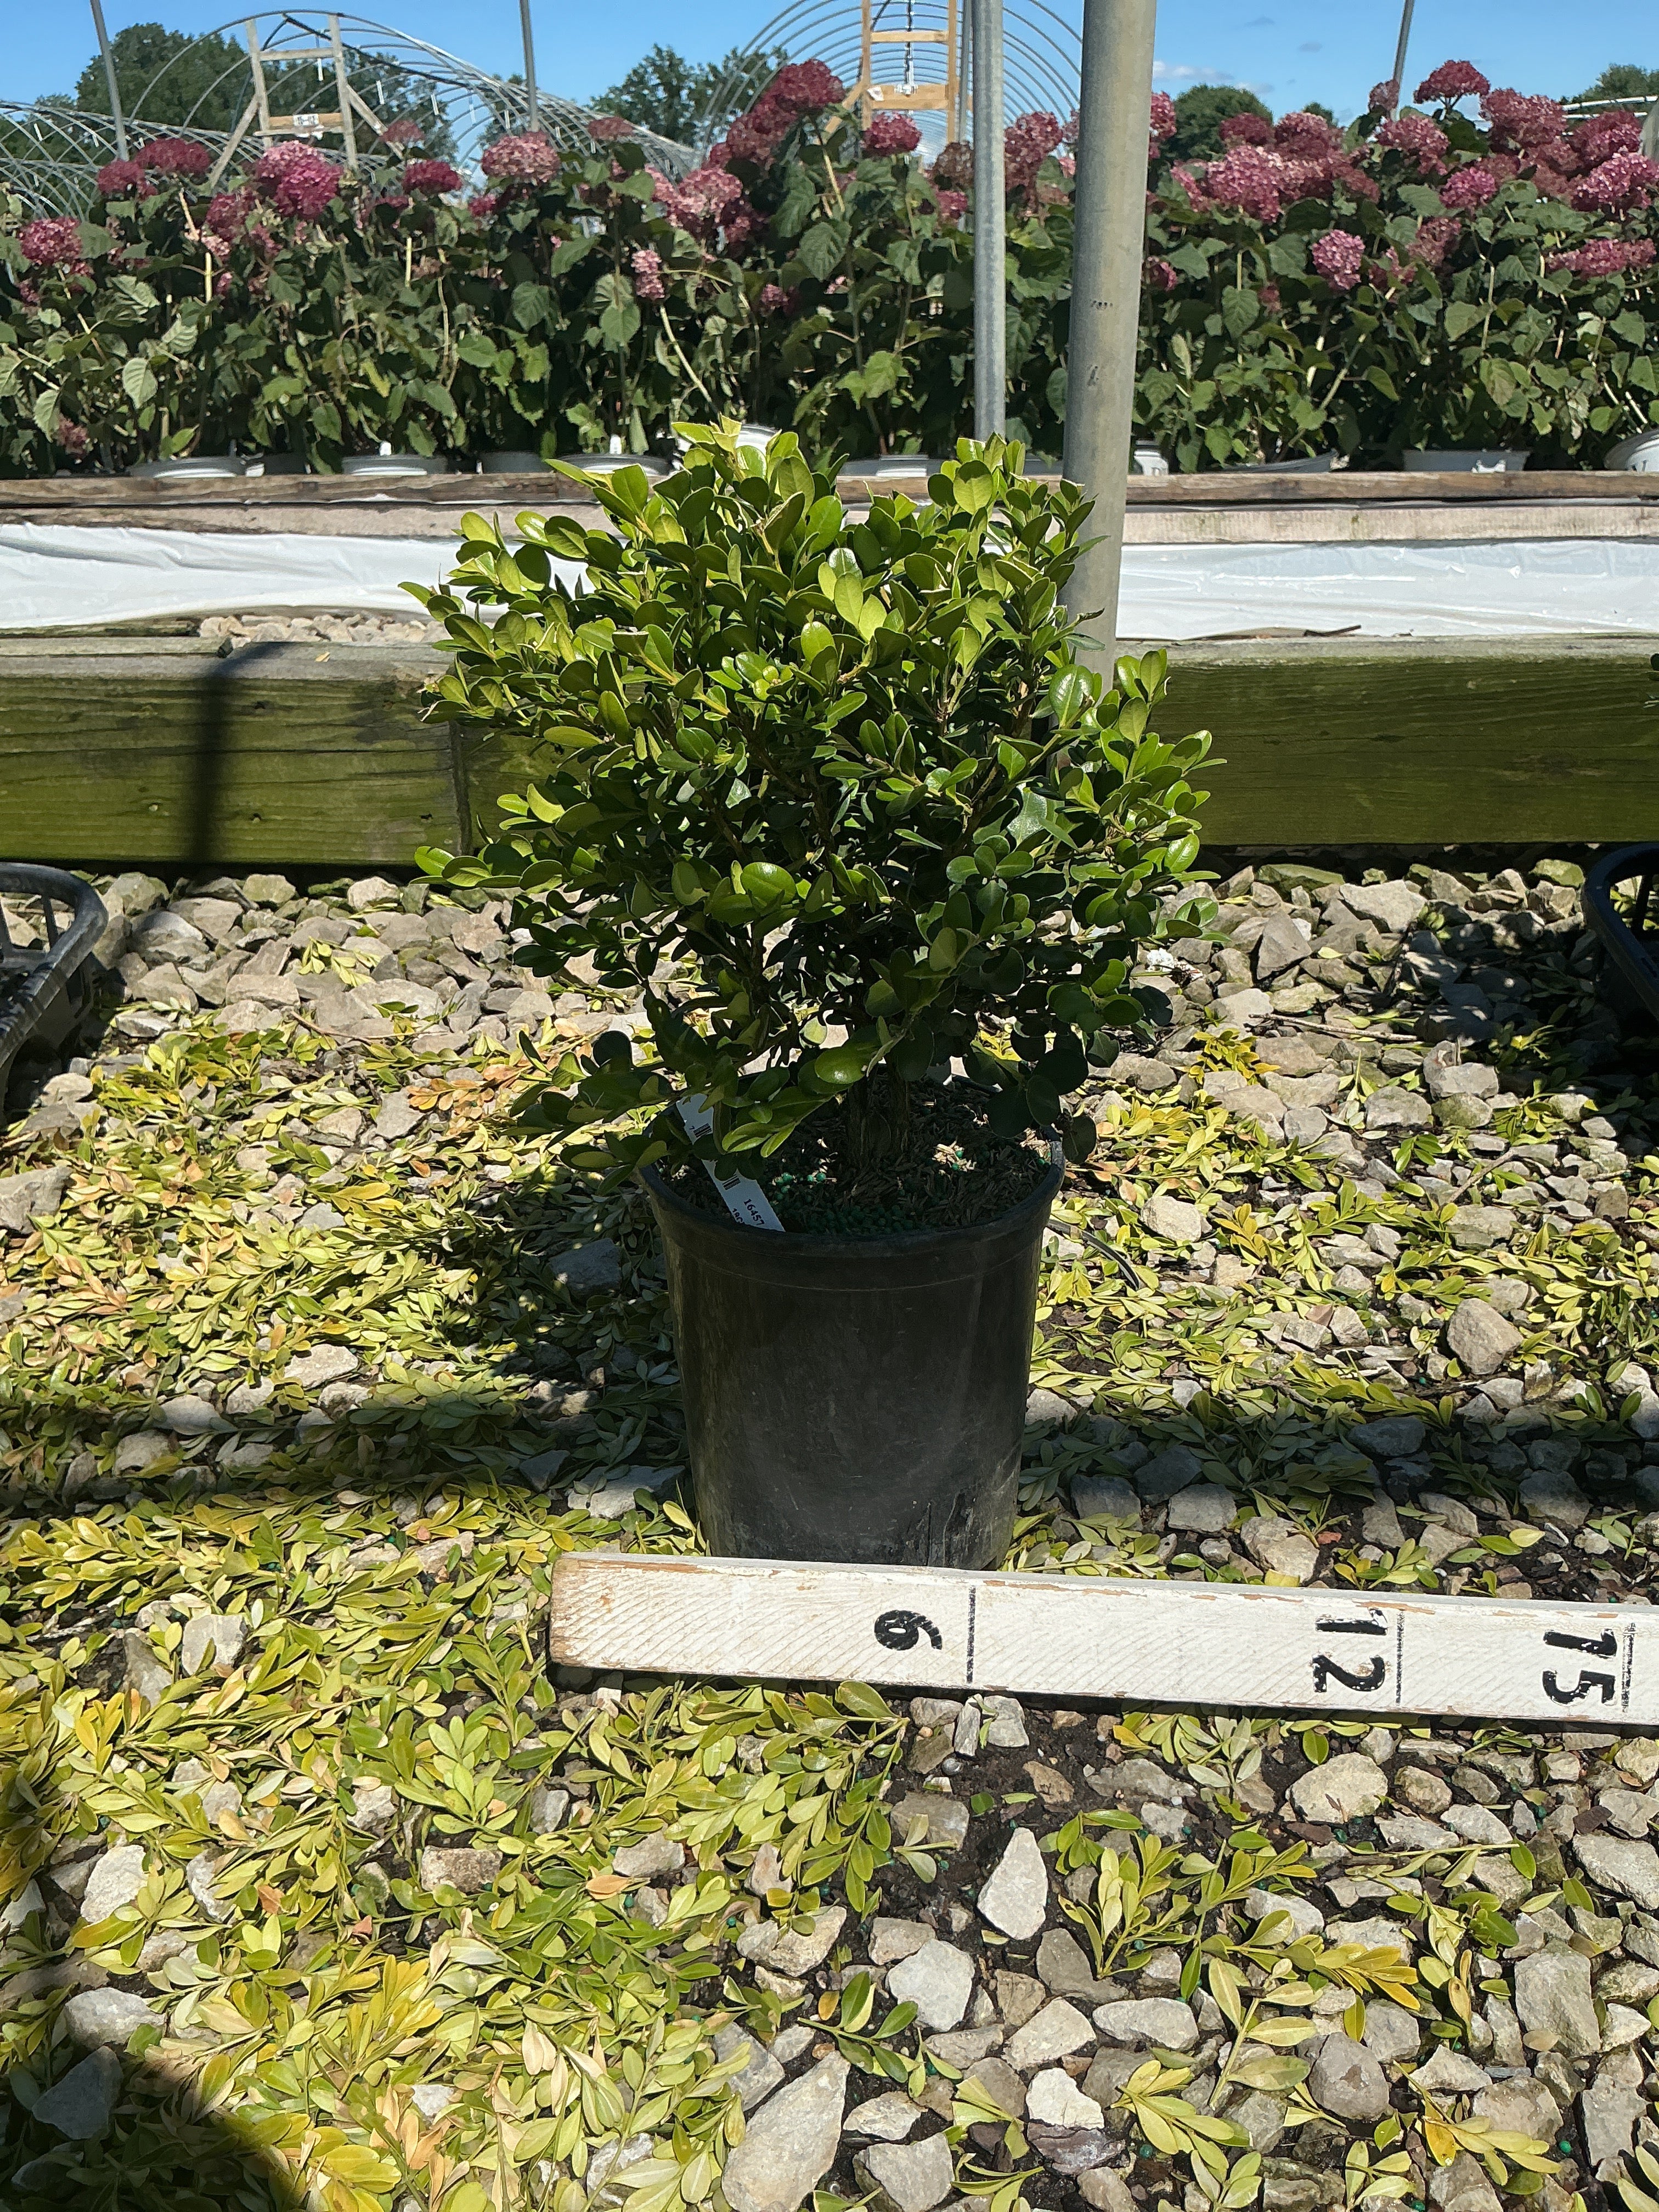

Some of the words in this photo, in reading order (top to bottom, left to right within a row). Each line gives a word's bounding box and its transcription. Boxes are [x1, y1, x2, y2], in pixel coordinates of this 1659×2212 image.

[743, 1198, 765, 1224] 16457
[874, 1610, 942, 1651] 6
[1313, 1608, 1387, 1692] 12
[1543, 1629, 1617, 1705] 15
